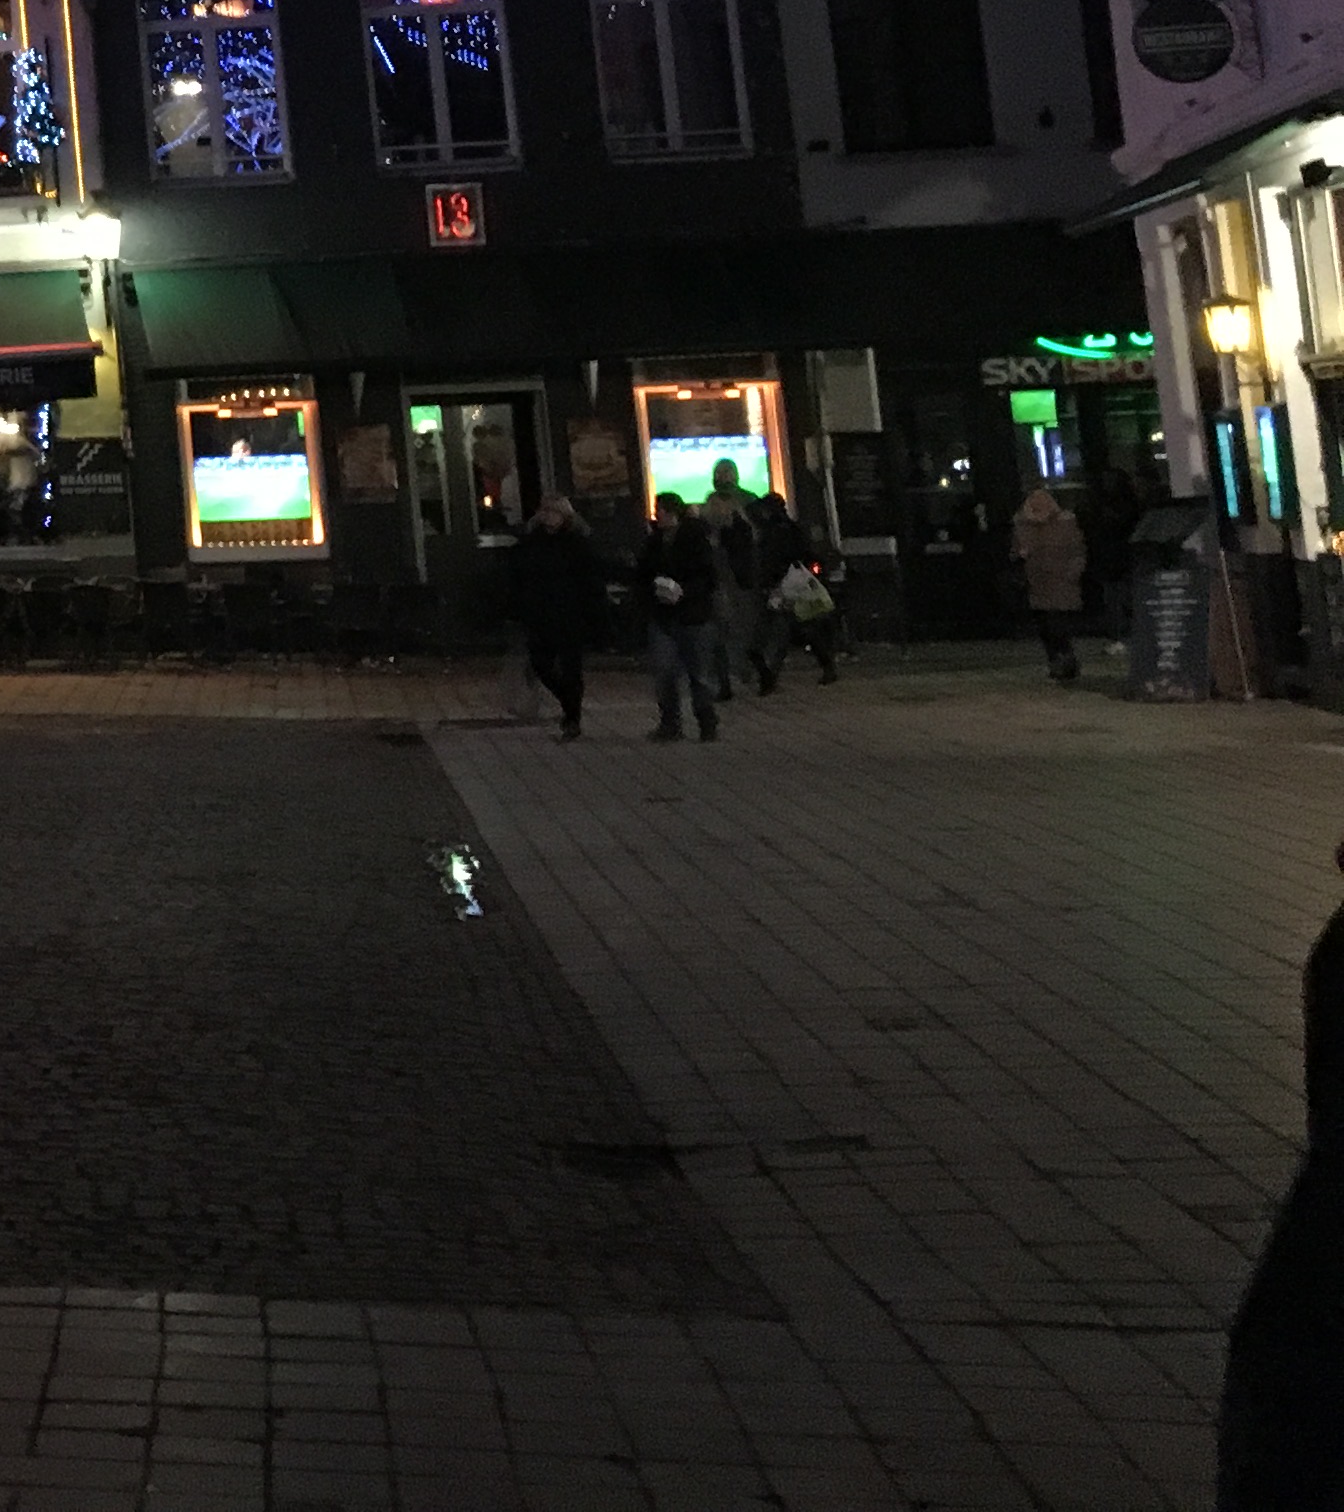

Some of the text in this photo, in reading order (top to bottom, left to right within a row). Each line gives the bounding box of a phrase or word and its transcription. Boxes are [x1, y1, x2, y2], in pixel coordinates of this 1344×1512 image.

[434, 192, 476, 238] 13
[981, 354, 1156, 386] SKY SPO
